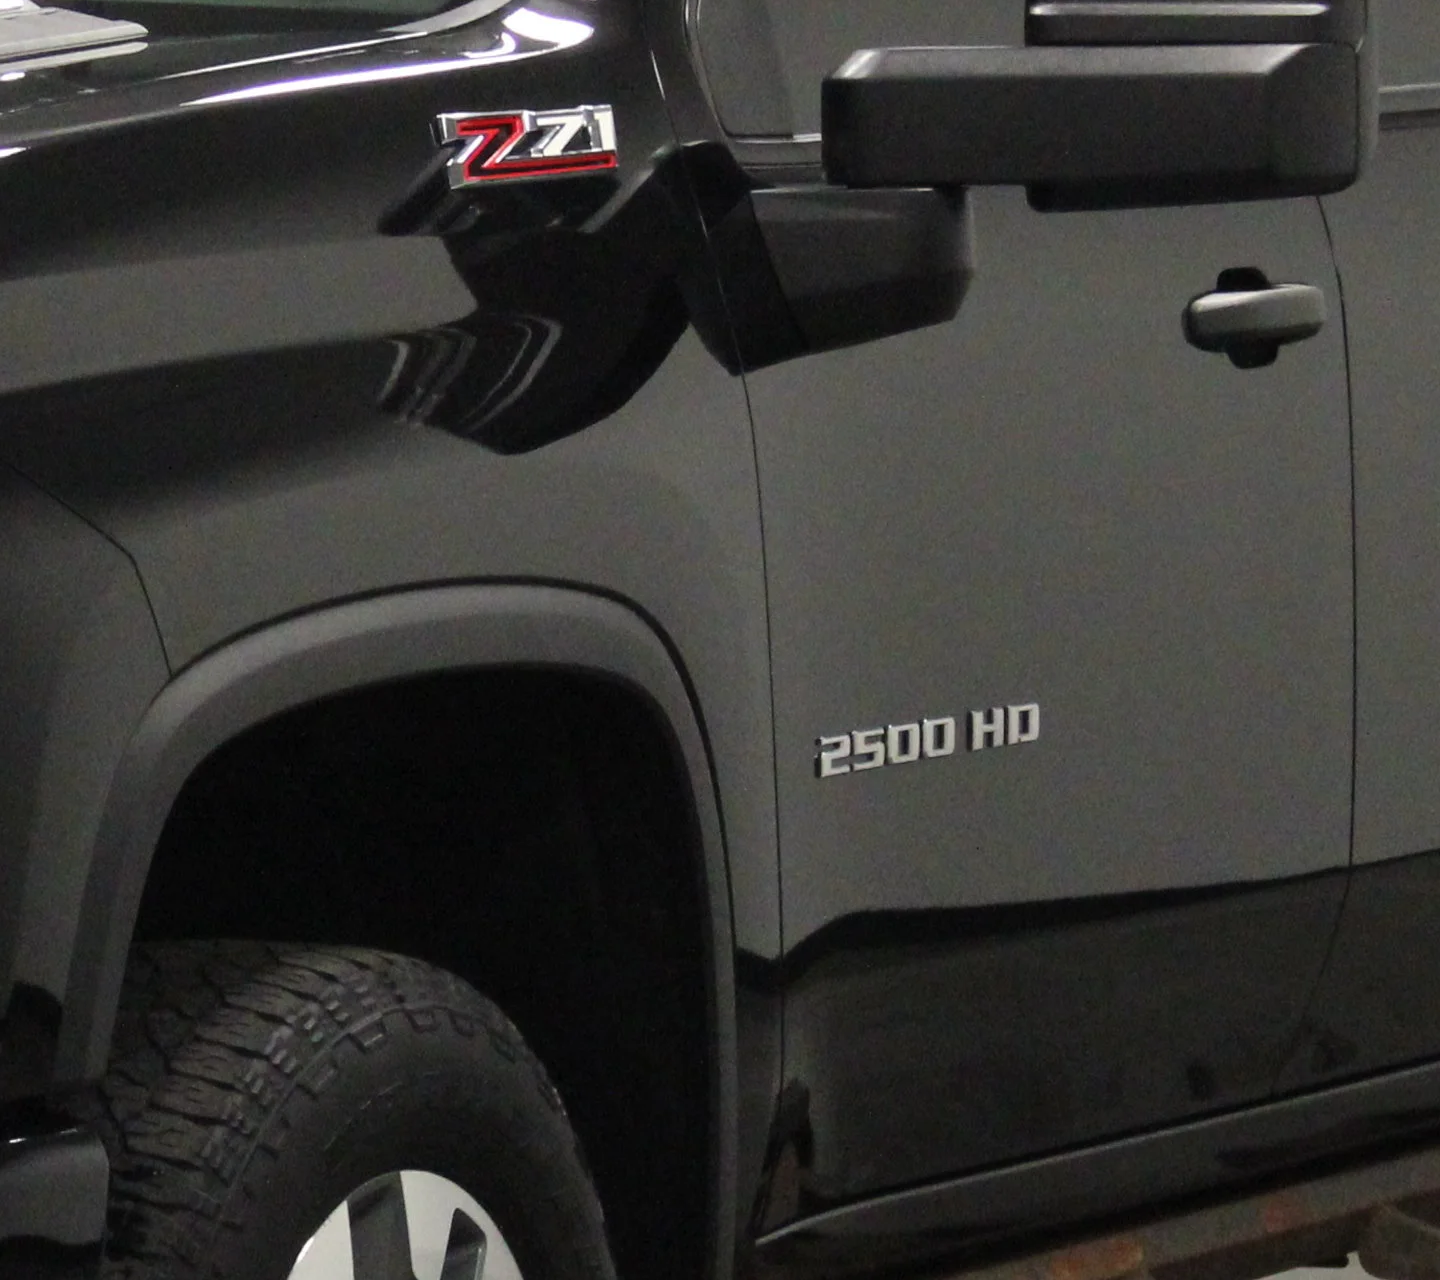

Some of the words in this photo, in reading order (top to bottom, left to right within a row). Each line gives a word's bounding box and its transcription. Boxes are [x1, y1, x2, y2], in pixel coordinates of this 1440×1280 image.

[435, 104, 618, 189] Z71
[816, 716, 956, 778] 2500
[969, 702, 1040, 752] HD
